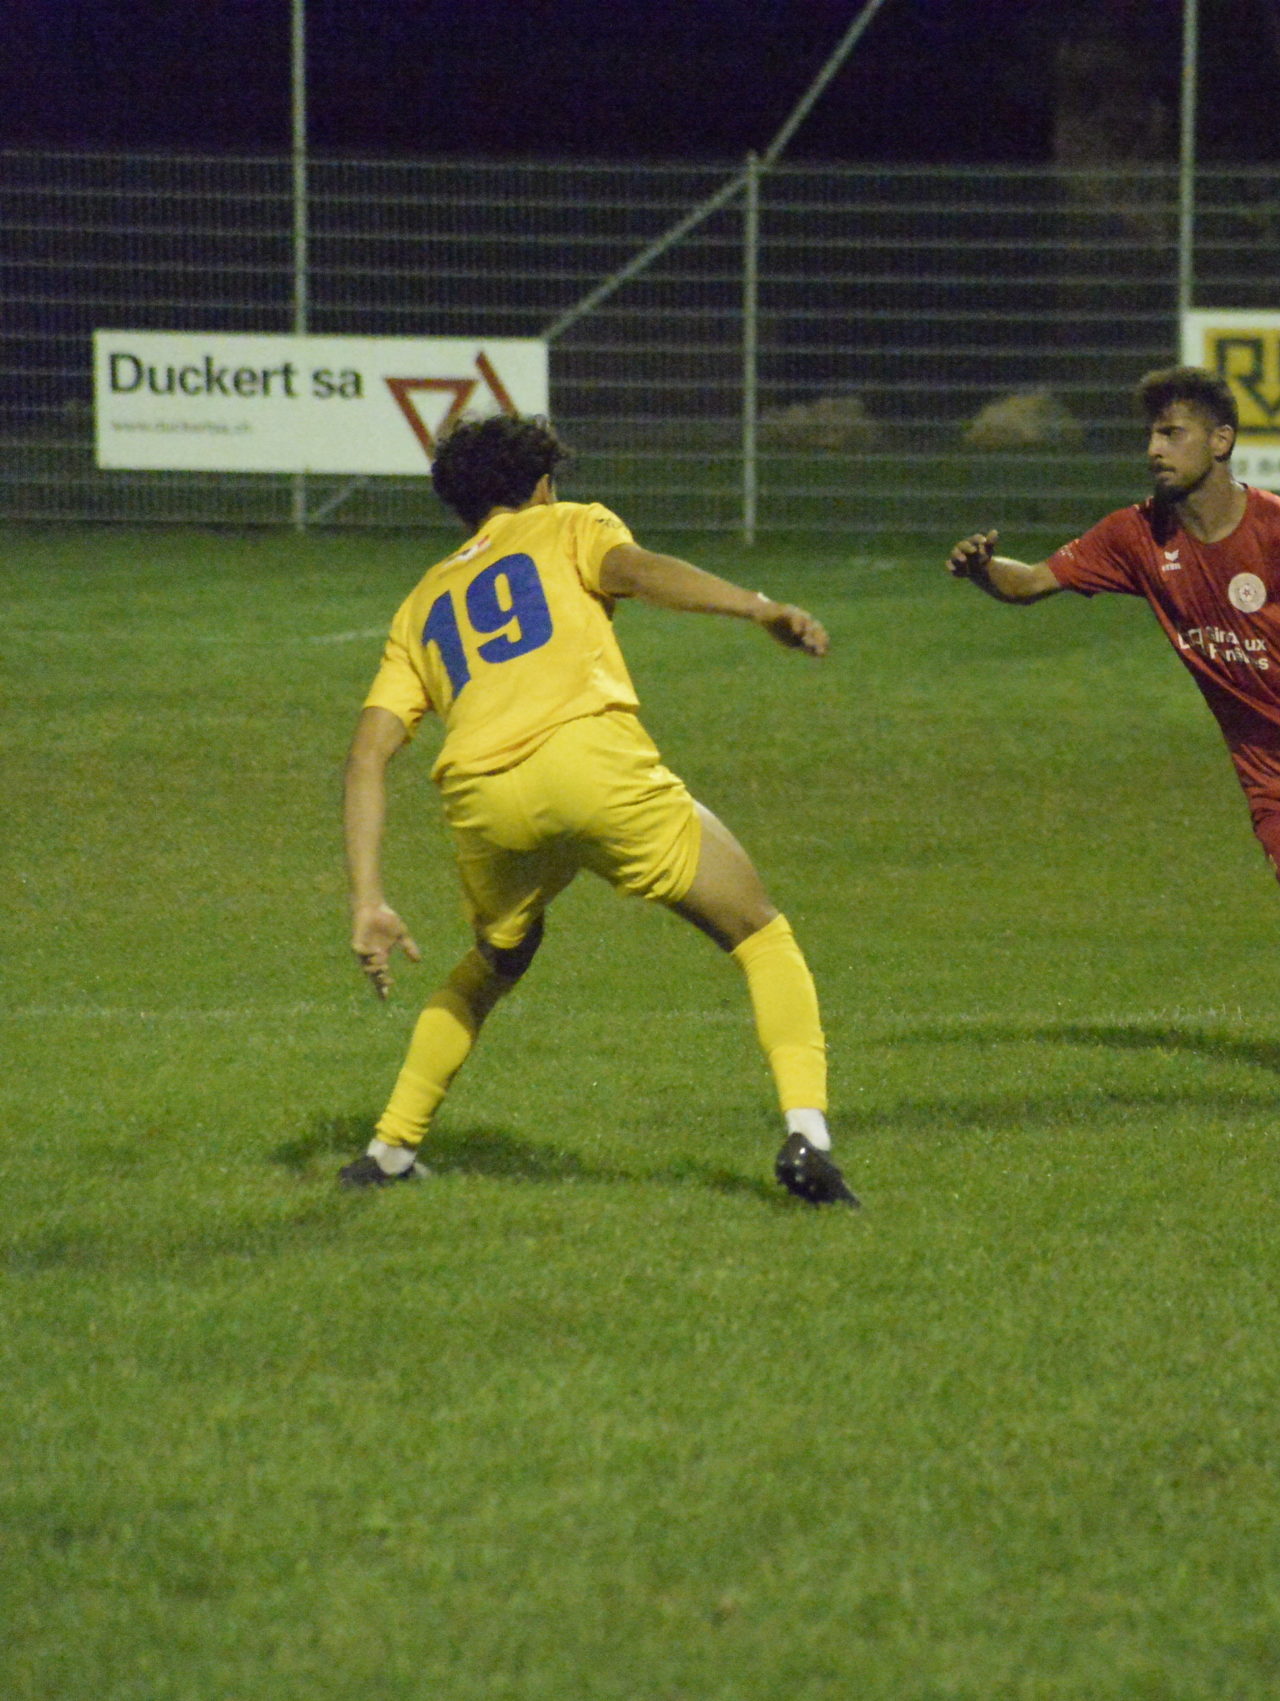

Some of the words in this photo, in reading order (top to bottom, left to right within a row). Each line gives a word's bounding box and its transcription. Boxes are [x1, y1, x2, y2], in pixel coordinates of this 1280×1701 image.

[109, 353, 299, 397] Duckert
[313, 367, 365, 400] sa
[421, 552, 553, 700] 19
